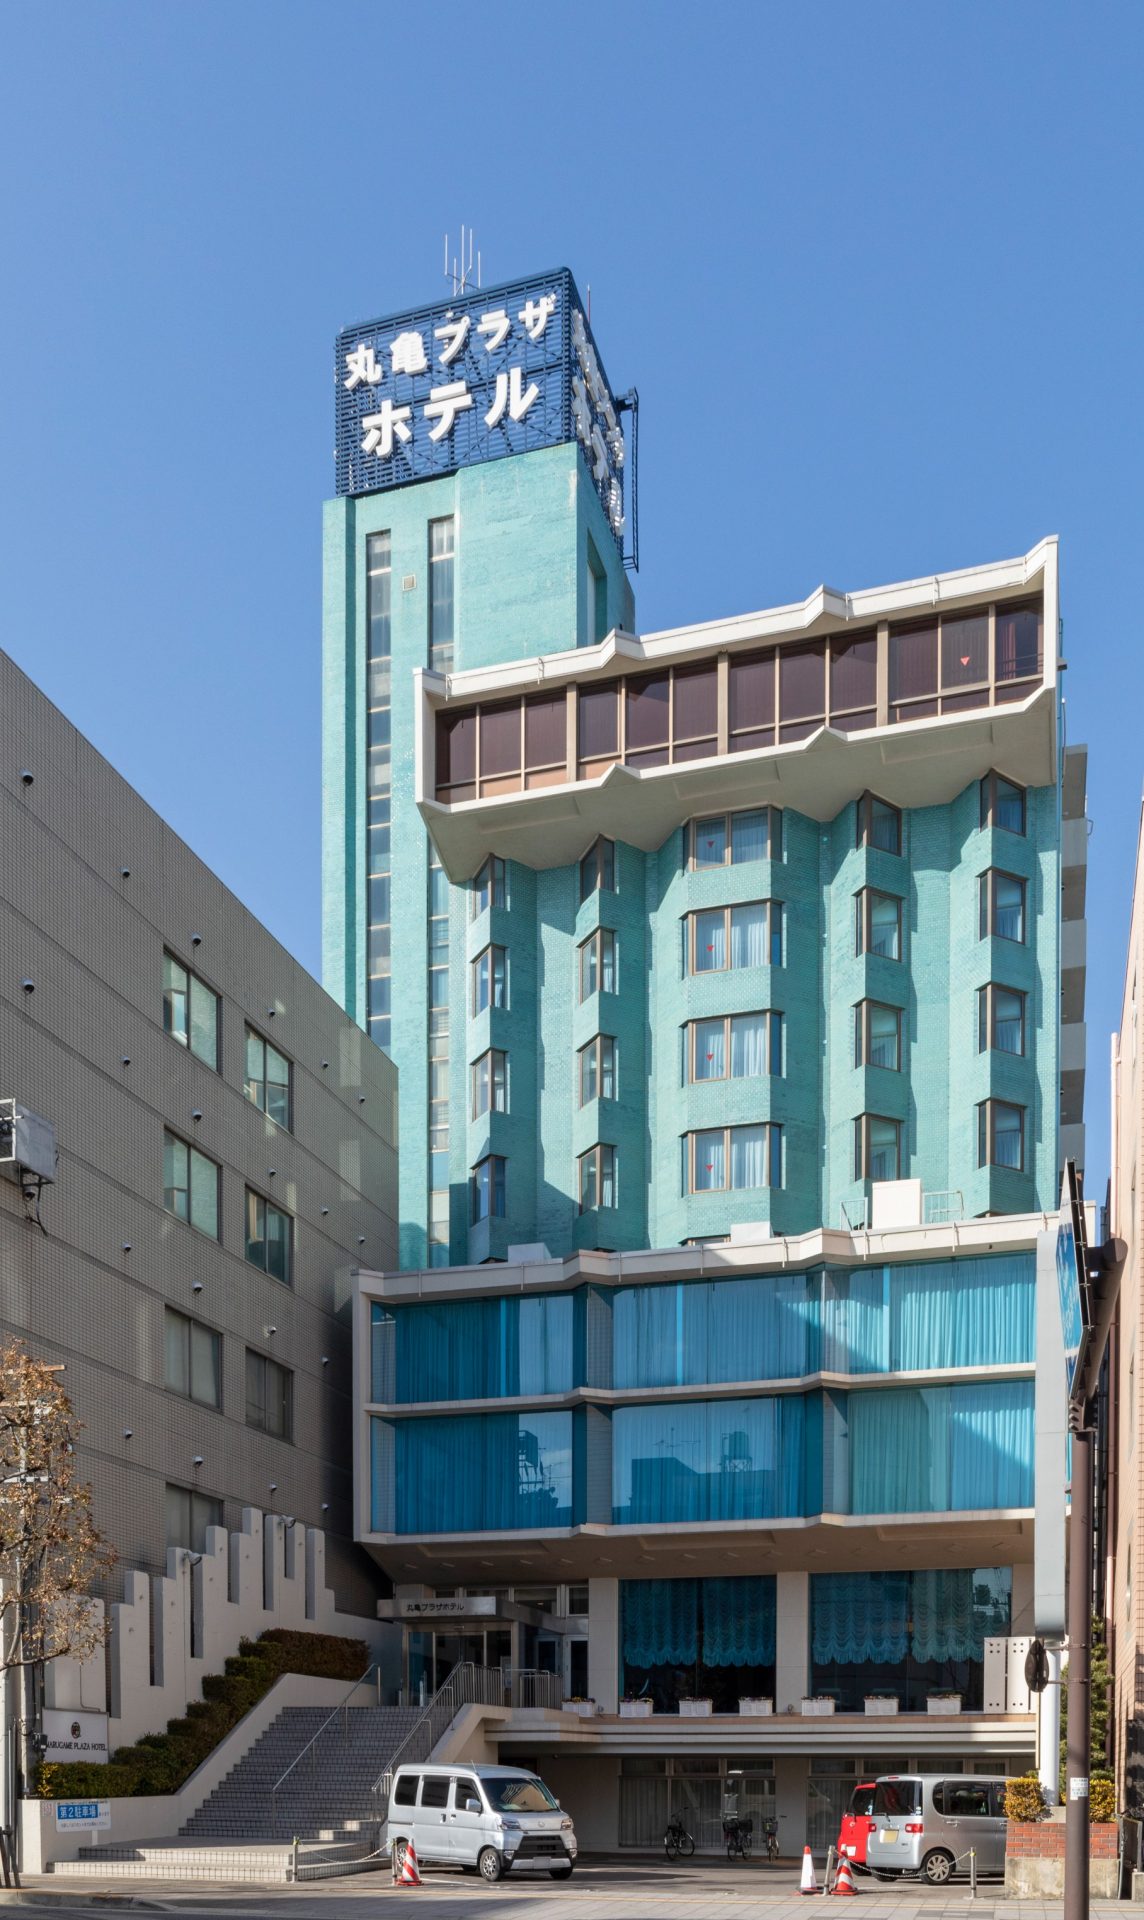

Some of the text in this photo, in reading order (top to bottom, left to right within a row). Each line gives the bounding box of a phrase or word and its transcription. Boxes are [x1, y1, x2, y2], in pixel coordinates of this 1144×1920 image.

[344, 291, 557, 390] 丸亀プラザ
[361, 366, 540, 459] ホテル
[406, 1603, 465, 1612] 丸亀プラザホテル
[91, 1743, 107, 1751] HOTEL
